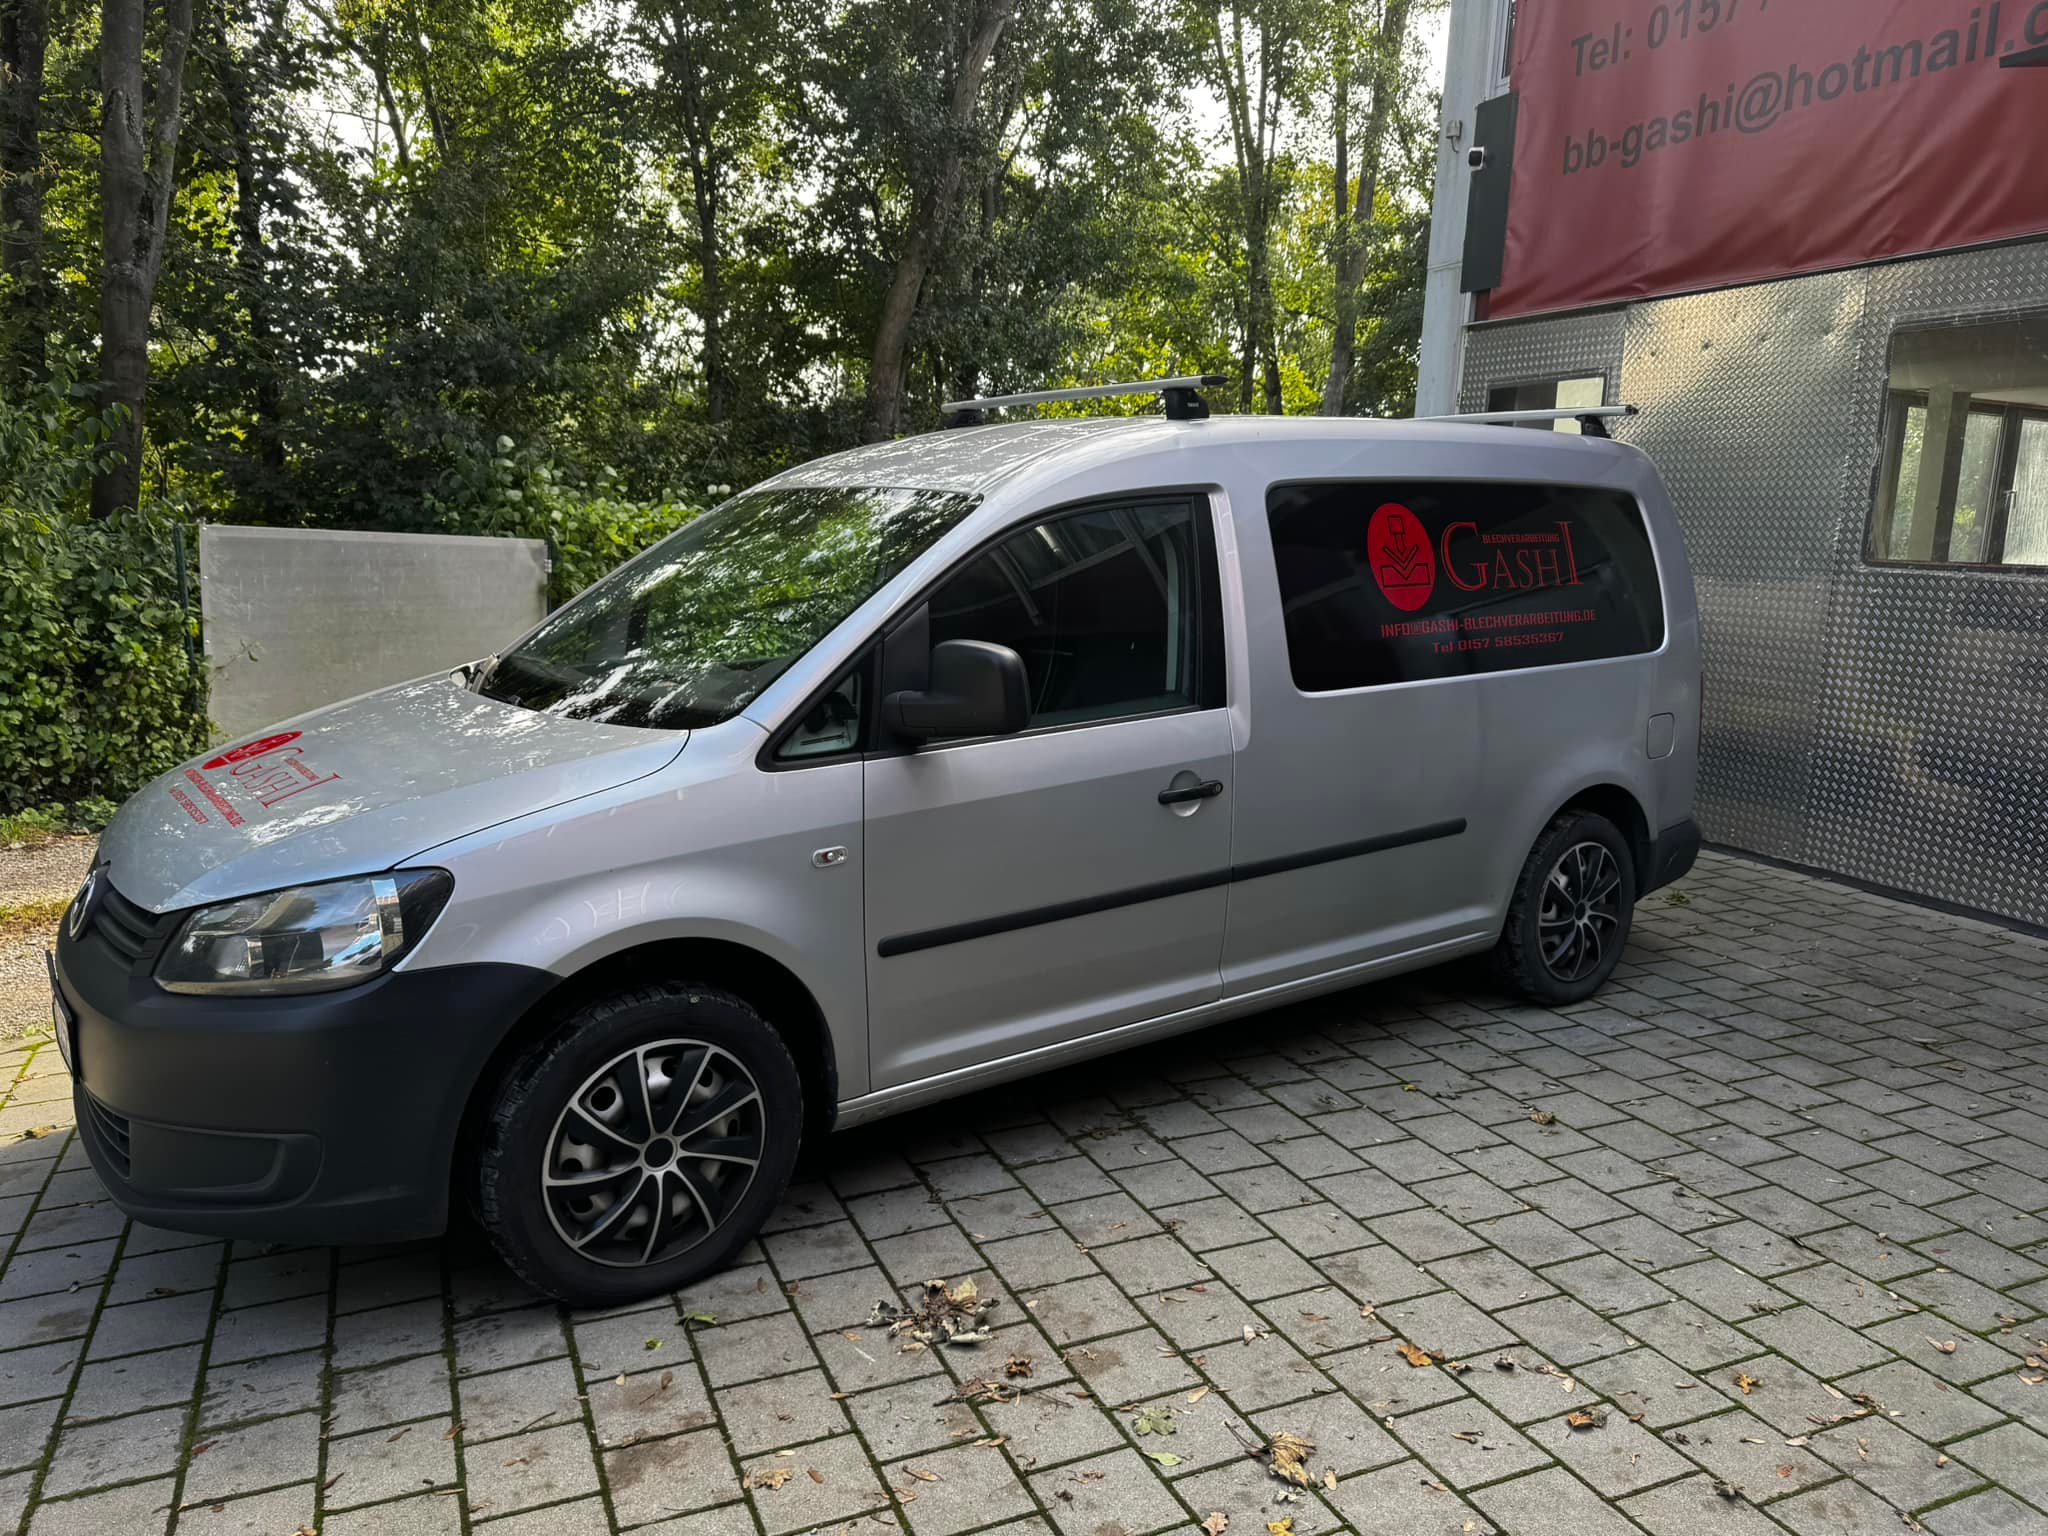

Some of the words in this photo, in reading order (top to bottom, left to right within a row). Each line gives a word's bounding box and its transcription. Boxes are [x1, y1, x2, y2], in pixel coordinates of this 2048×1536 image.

[1571, 22, 1633, 78] Tel:
[1441, 520, 1584, 591] GASHI
[1432, 640, 1454, 655] Tel
[1457, 638, 1490, 652] 0157
[229, 747, 343, 809] GASHI
